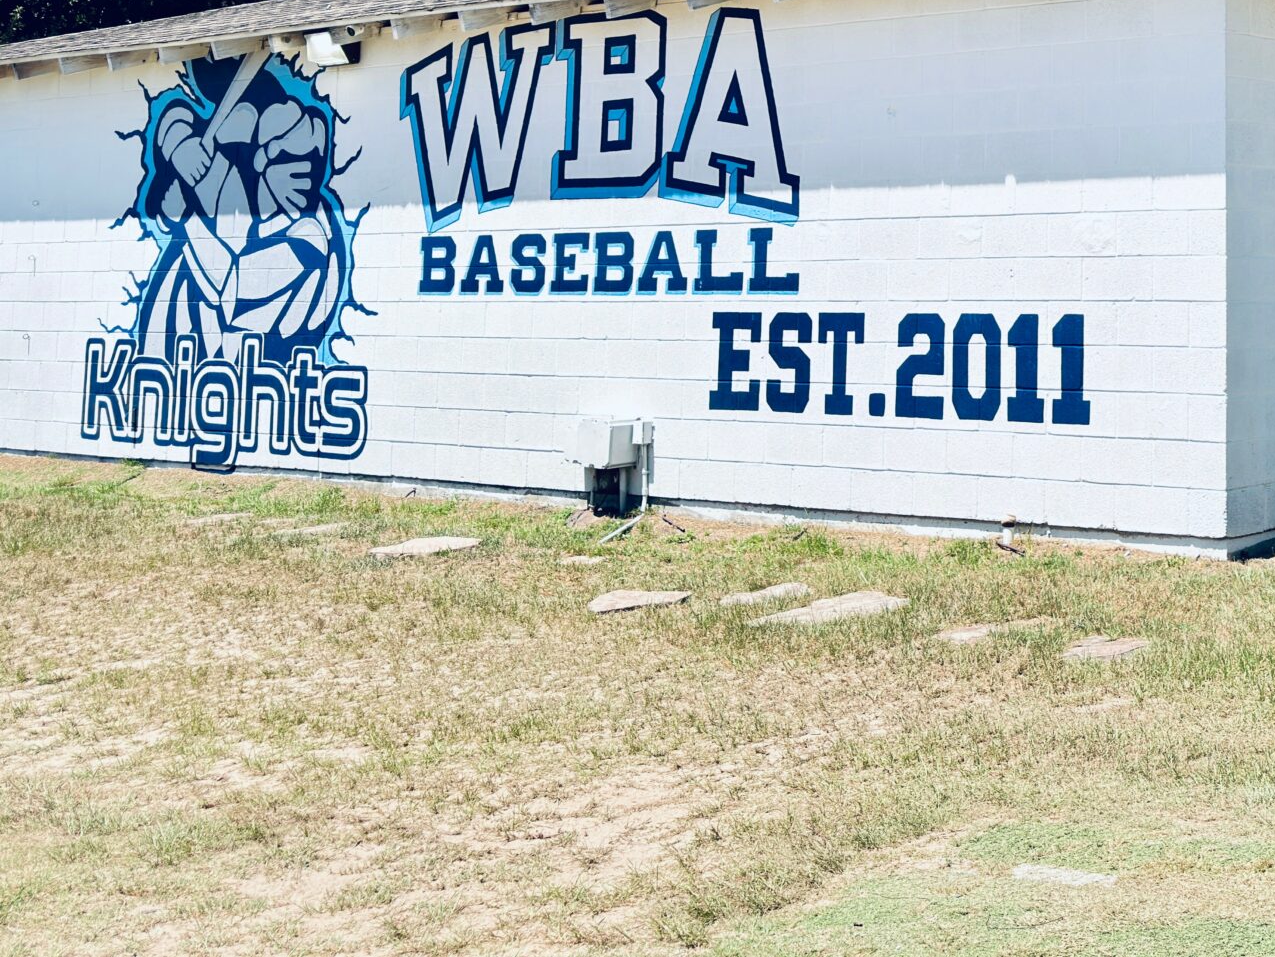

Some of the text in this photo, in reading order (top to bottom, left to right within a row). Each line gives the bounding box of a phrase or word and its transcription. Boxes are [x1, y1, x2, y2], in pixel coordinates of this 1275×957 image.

[400, 7, 800, 231] WBA
[418, 228, 800, 296] BASEBALL
[81, 332, 369, 473] Knights
